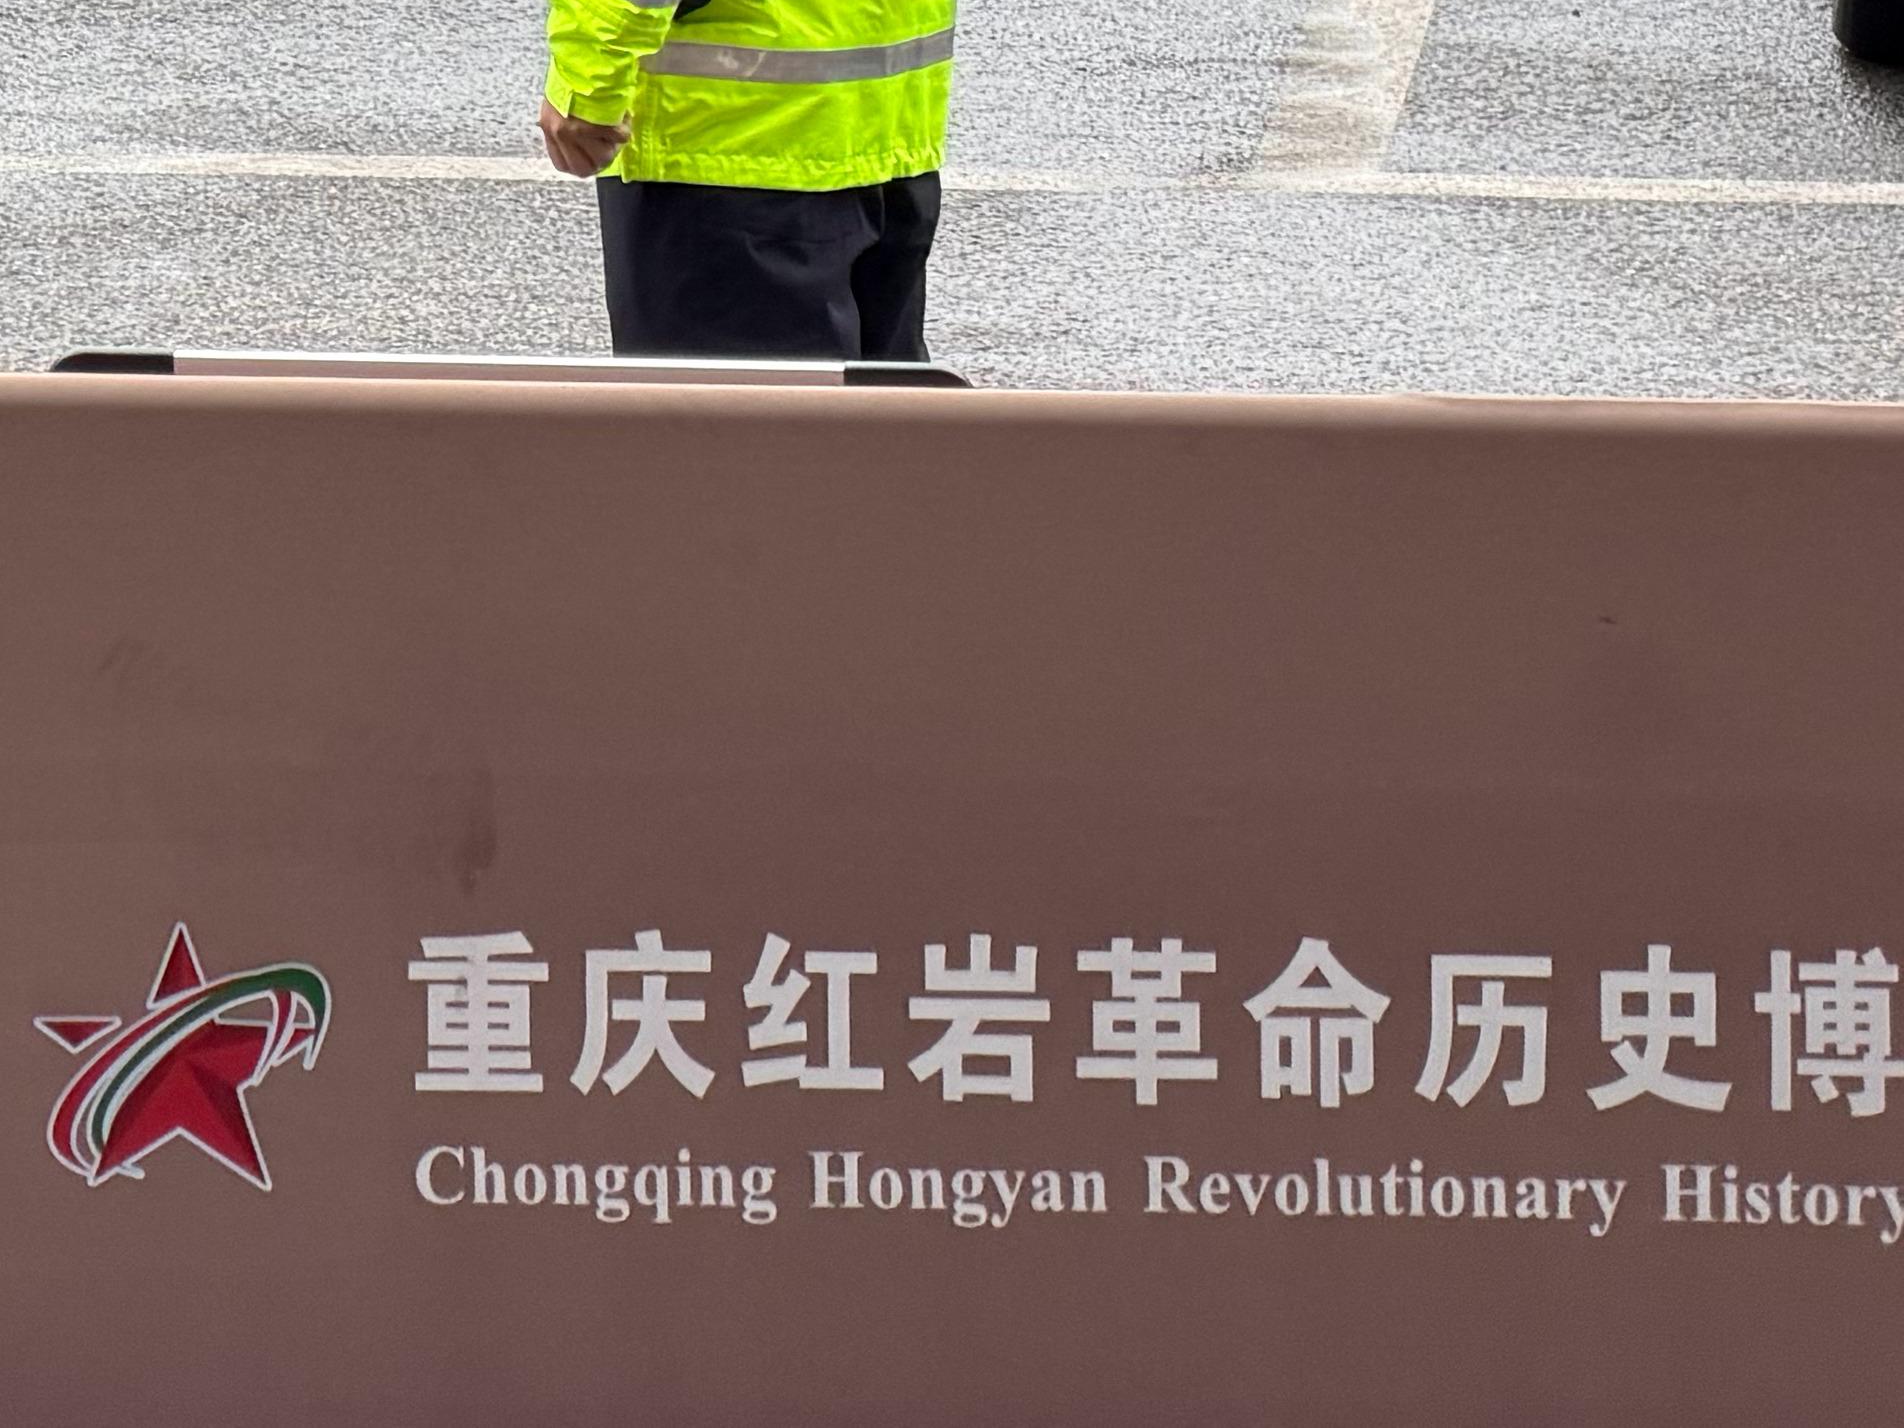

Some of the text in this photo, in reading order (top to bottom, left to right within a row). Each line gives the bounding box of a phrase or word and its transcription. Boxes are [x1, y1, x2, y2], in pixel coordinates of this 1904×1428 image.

[408, 930, 1904, 1116] 重庆红岩革命历史博
[415, 1146, 1904, 1245] Chongqing Hongyan Revolutionary History
